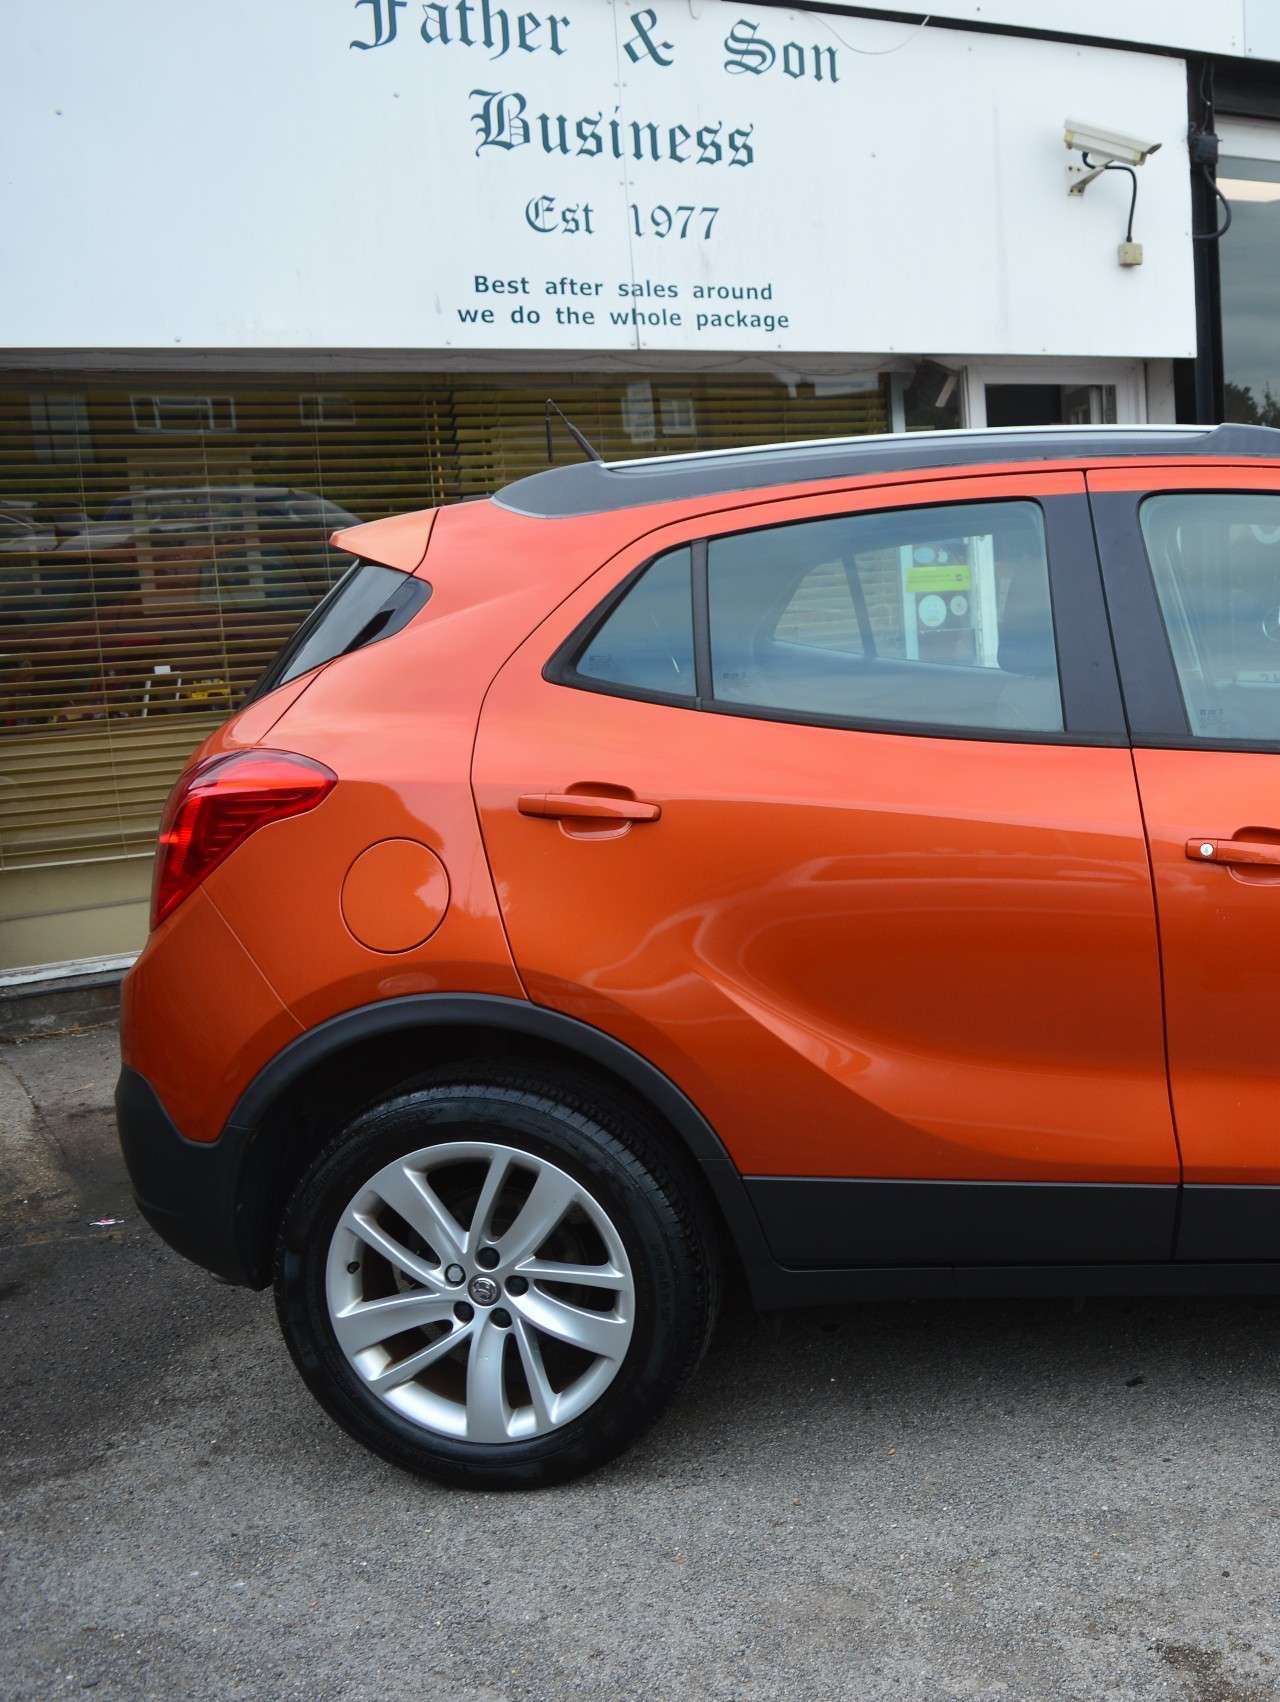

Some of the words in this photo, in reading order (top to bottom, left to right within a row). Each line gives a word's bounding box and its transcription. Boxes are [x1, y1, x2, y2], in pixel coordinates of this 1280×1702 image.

[622, 8, 675, 67] &
[724, 18, 840, 84] Son
[468, 88, 756, 168] Business
[525, 194, 596, 235] Est
[629, 203, 720, 240] 1977
[474, 275, 530, 295] Best
[545, 277, 604, 296] after
[618, 280, 679, 298] sales
[692, 283, 773, 301] around
[457, 307, 495, 324] we
[510, 306, 541, 325] do
[556, 307, 595, 325] the
[609, 308, 682, 327] whole
[696, 311, 789, 332] package
